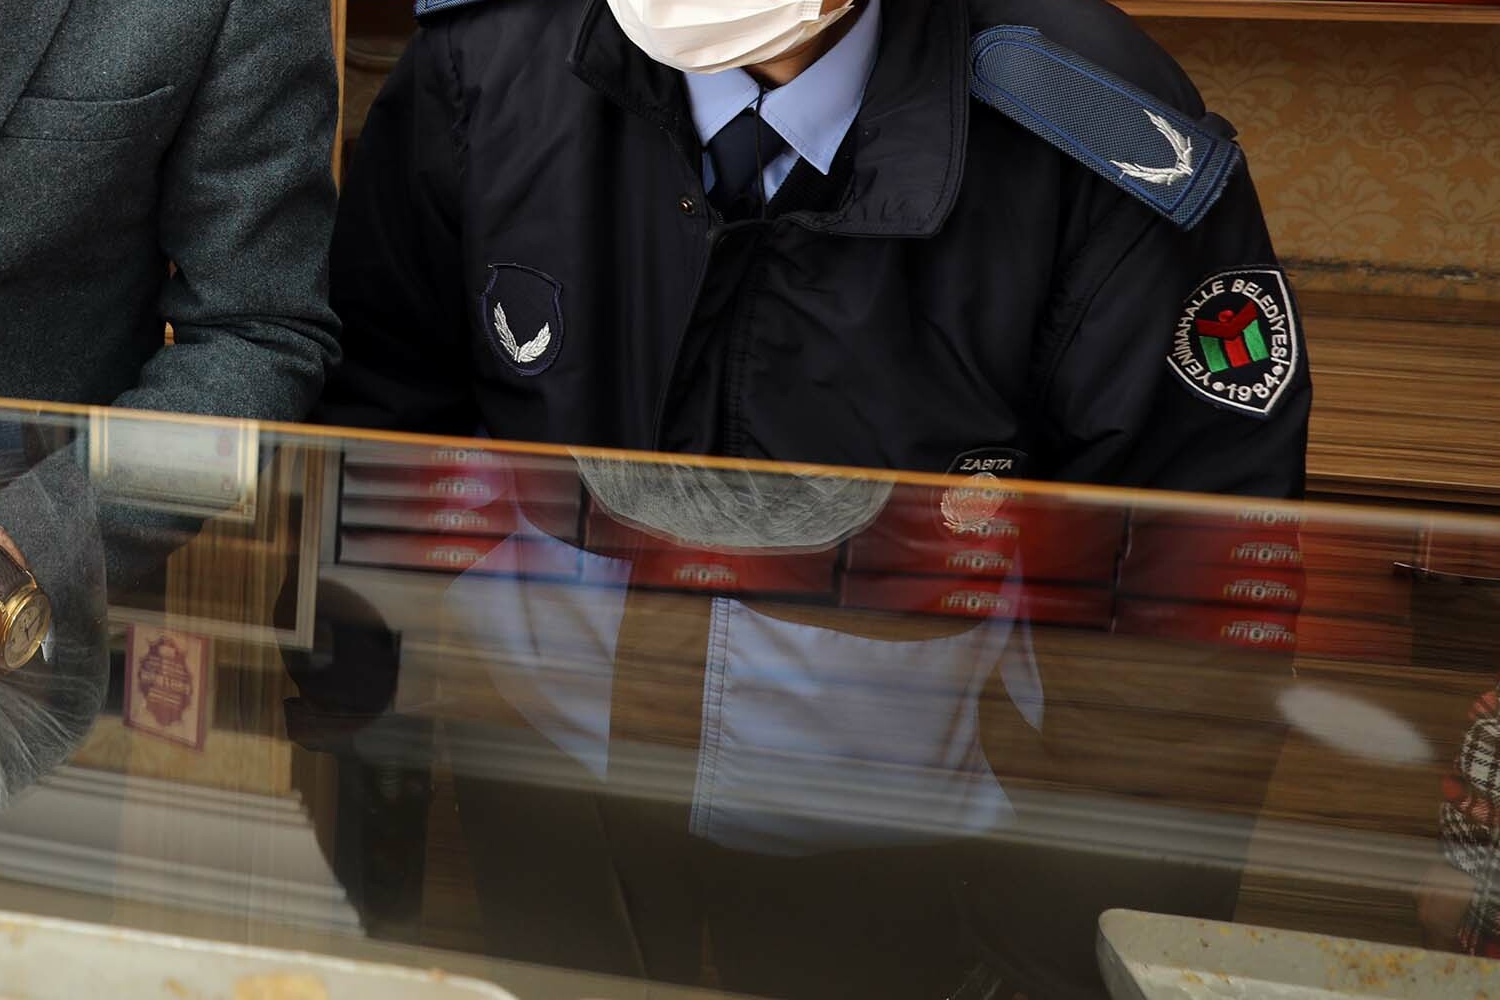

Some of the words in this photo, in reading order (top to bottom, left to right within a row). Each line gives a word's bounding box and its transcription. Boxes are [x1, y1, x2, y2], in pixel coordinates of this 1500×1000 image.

[1172, 280, 1225, 386] YENİMAHALLE
[1231, 278, 1290, 366] BELEDİYESİ
[1226, 372, 1280, 401] 1984
[960, 459, 1012, 471] ZABITA
